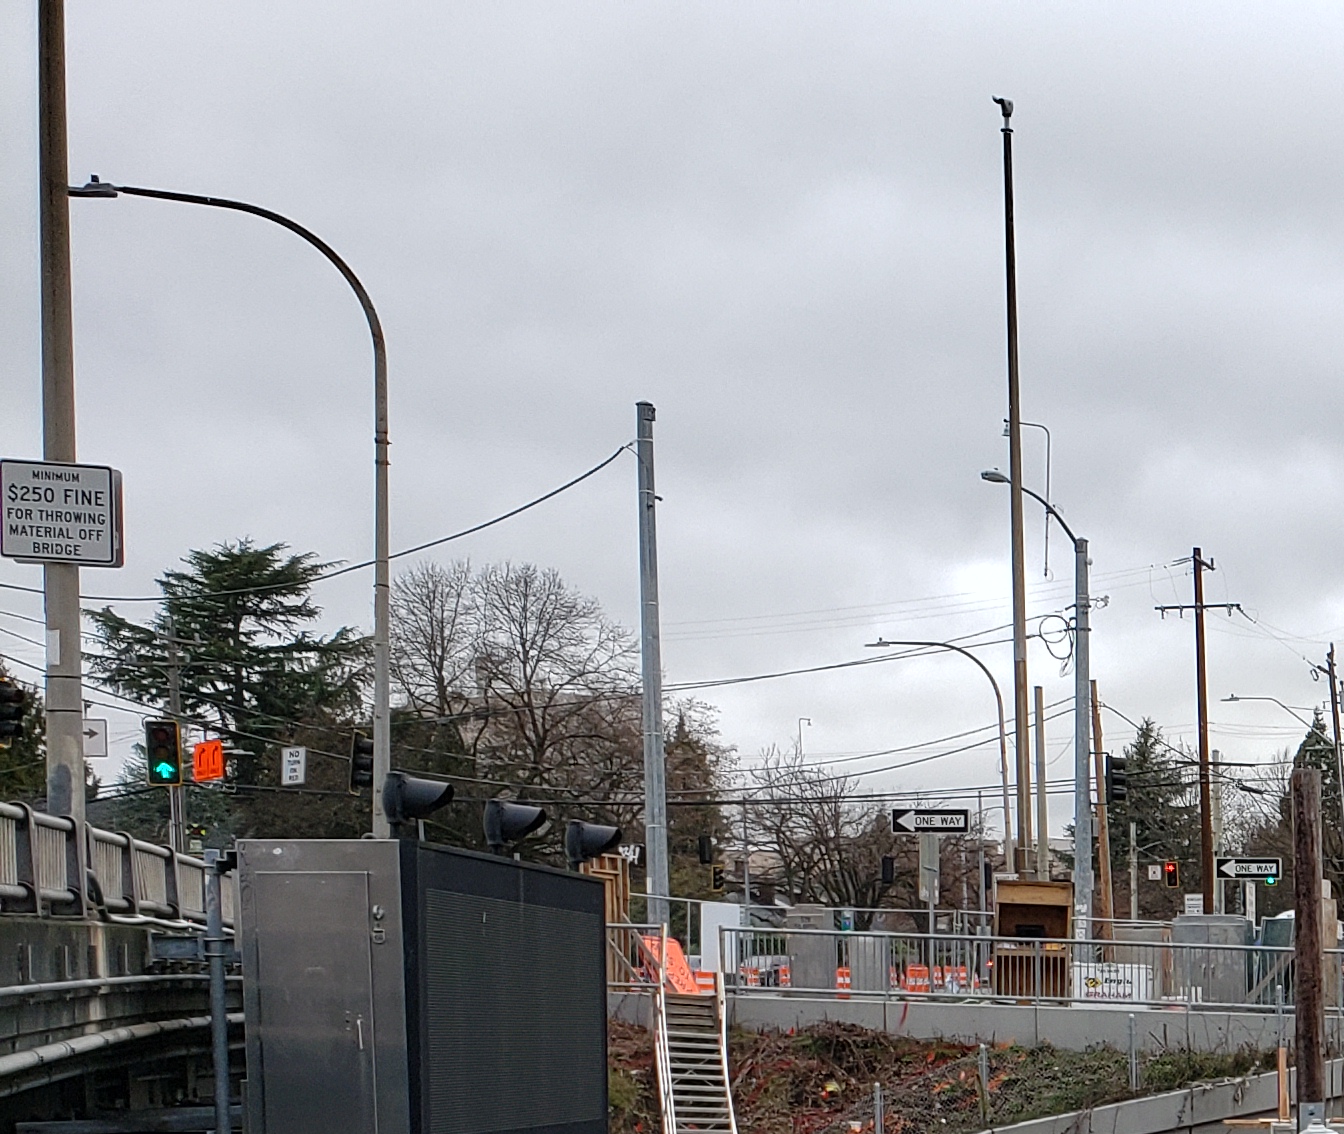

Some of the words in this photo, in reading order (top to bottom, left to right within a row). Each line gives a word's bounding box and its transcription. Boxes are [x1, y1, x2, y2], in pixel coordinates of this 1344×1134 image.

[32, 470, 80, 483] MINIMUM
[8, 483, 55, 503] $250
[63, 489, 105, 506] FINE
[7, 507, 33, 520] FOR
[38, 509, 106, 525] THROWING
[9, 524, 74, 540] MATERIAL
[79, 529, 104, 541] OFF
[32, 542, 82, 556] BRIDGE
[915, 816, 935, 826] ONE
[940, 816, 962, 826] WAY
[1235, 865, 1253, 873] ONE
[1256, 864, 1275, 873] WAY
